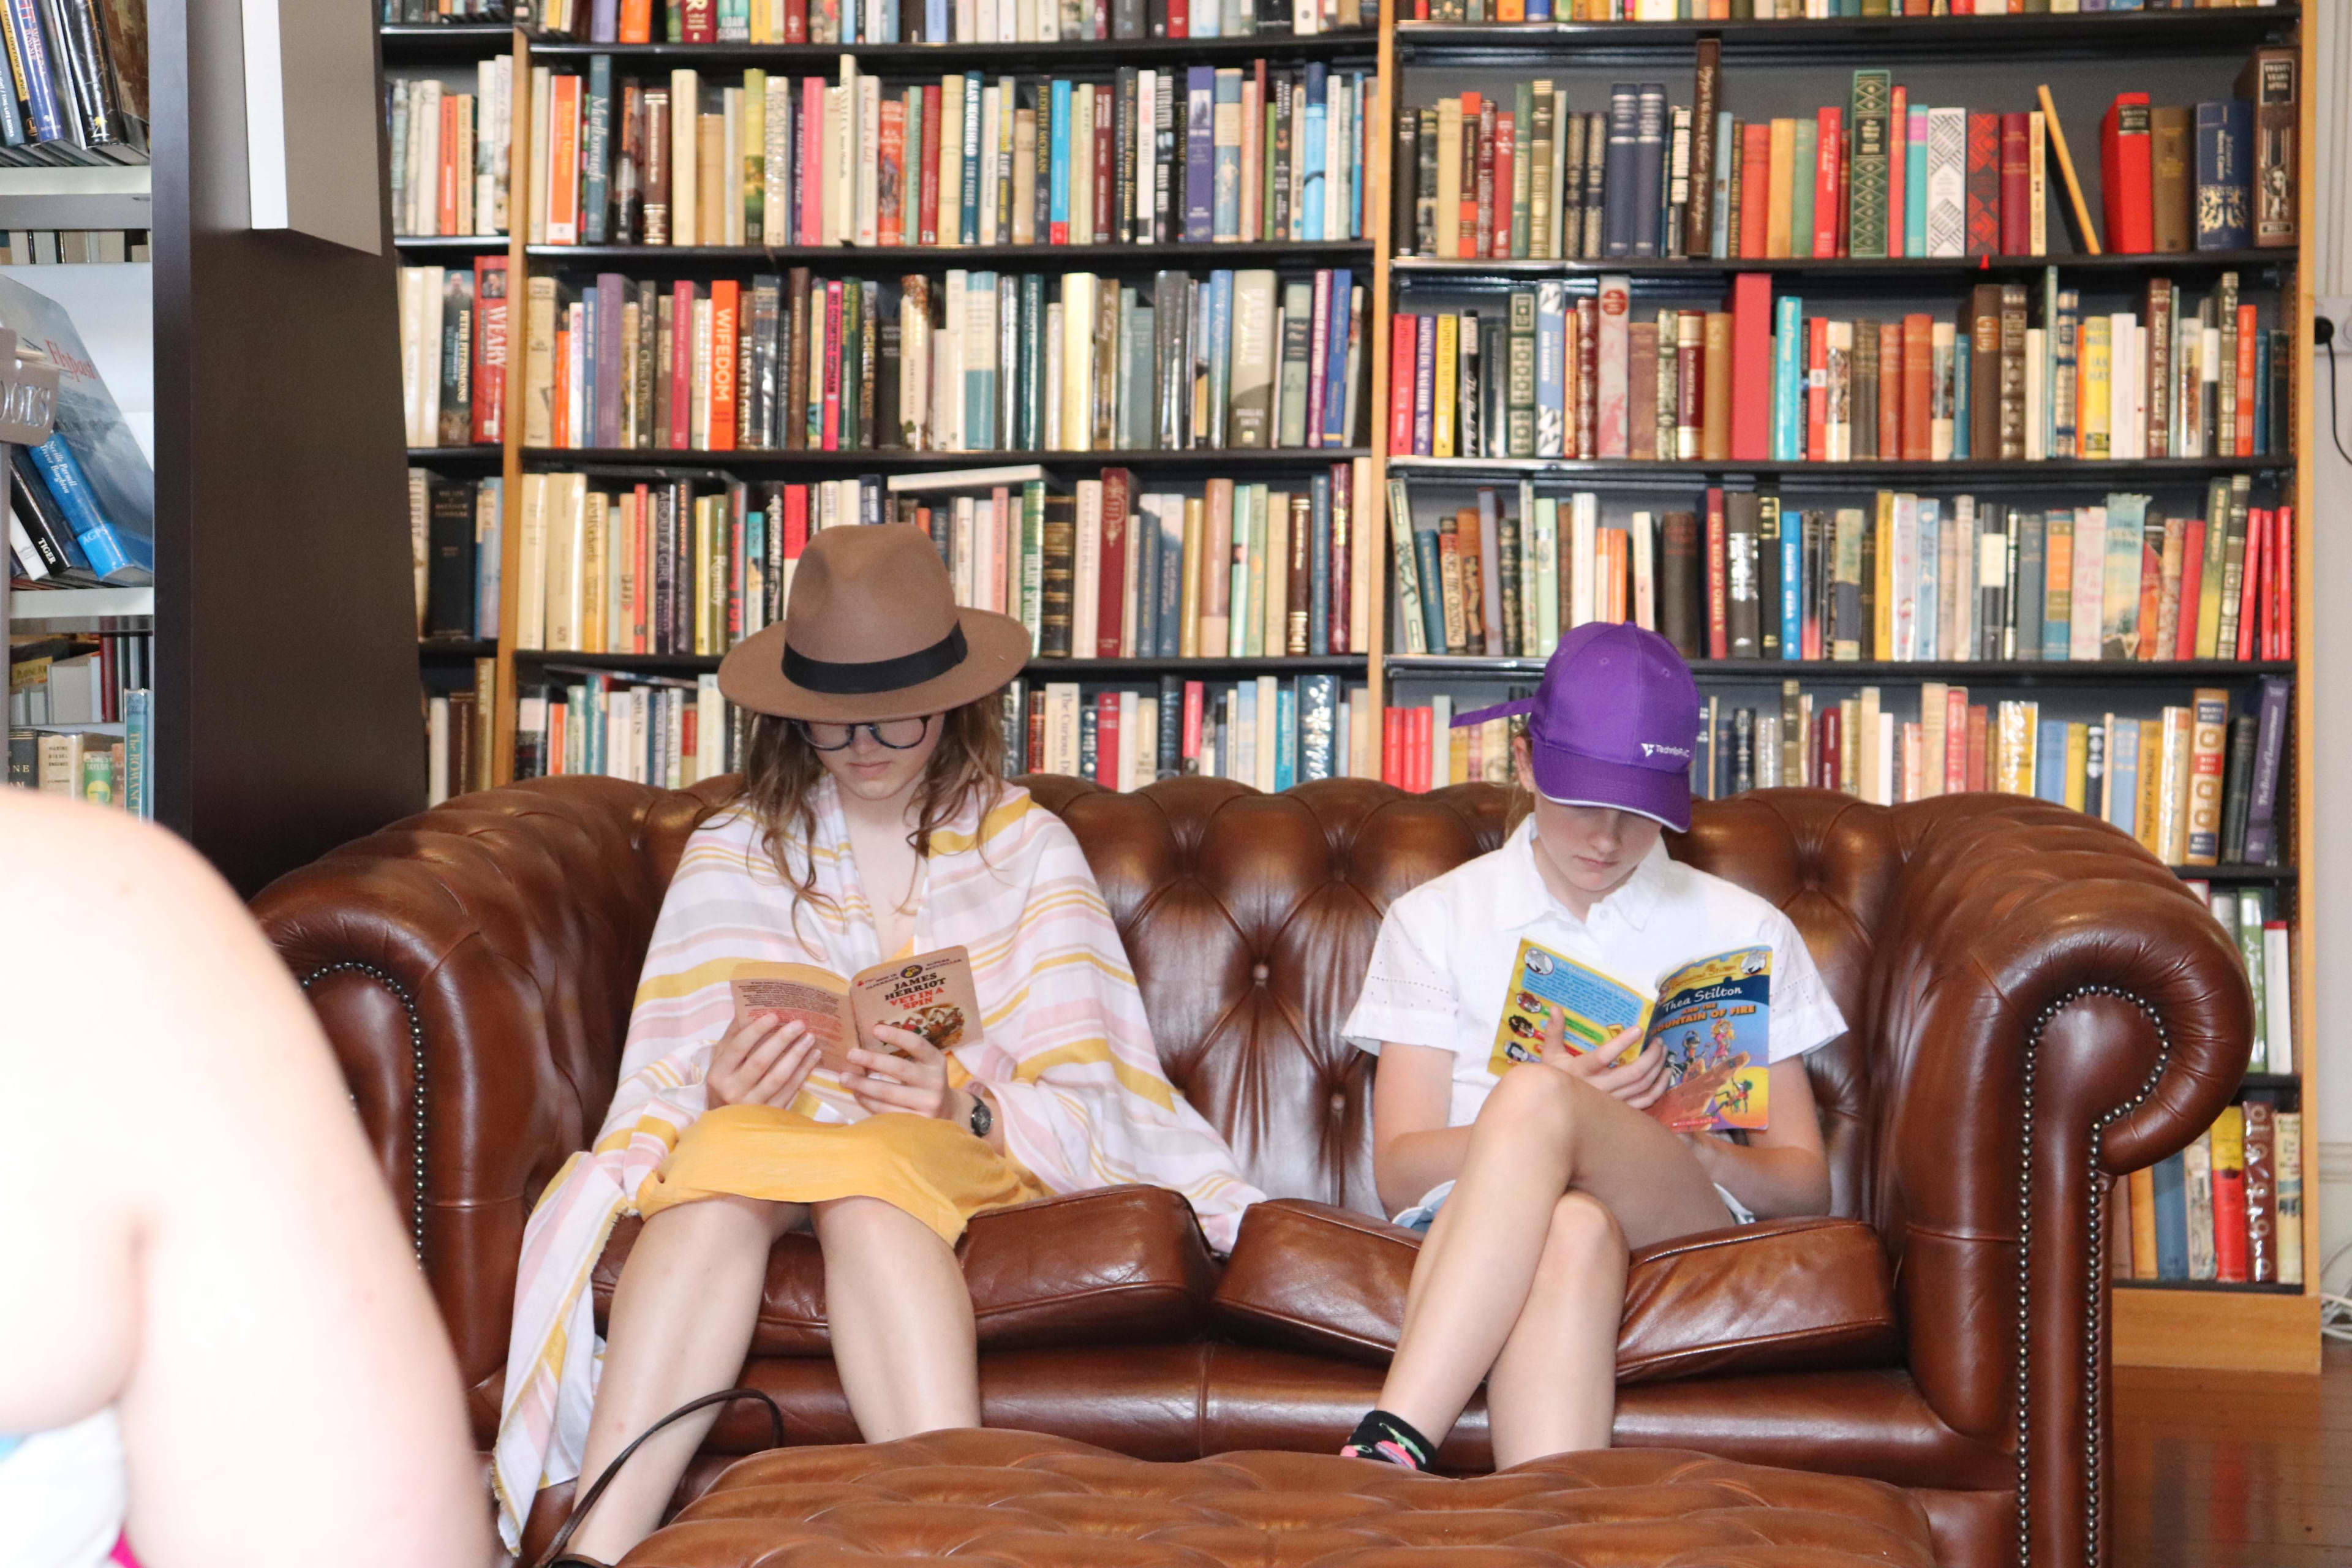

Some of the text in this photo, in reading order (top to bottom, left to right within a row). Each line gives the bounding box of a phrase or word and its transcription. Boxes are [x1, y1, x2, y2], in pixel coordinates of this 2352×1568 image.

[863, 97, 873, 113] have
[967, 79, 979, 101] ALAN
[1038, 86, 1048, 127] JUDITH
[587, 96, 609, 182] Marlborough
[965, 103, 978, 157] MOOREHEAD
[863, 145, 874, 162] hold
[1037, 130, 1047, 174] MORAN
[1124, 181, 1133, 221] Minister
[457, 310, 469, 402] PETER FITZSIMONS
[487, 306, 507, 366] WEARY
[715, 308, 731, 402] WIFEDOM
[862, 320, 874, 380] MICHELLE
[44, 339, 96, 383] Flypast
[639, 349, 650, 378] Chris
[1417, 317, 1431, 412] DAPHNE DU MAURIER
[40, 444, 70, 494] Trevor Boughton
[48, 440, 78, 486] Neville Parnell
[657, 491, 669, 584] ABOUT A GIRL
[1711, 511, 1721, 540] TIME
[38, 537, 56, 565] TIGER
[710, 555, 726, 607] Romilly
[1447, 597, 1464, 643] CROSSING
[1713, 589, 1722, 621] HERO
[129, 733, 141, 752] The
[1060, 692, 1072, 757] The Curious
[1159, 691, 1180, 761] MAGGIE
[884, 978, 946, 1001] HERRIOT
[889, 993, 916, 1006] VET
[918, 989, 933, 999] IN
[894, 972, 937, 991] JAMES
[1662, 986, 1743, 1012] Thea Stilton
[902, 997, 933, 1010] SPIN
[1709, 1009, 1727, 1019] OF
[1729, 1005, 1756, 1016] FIRE
